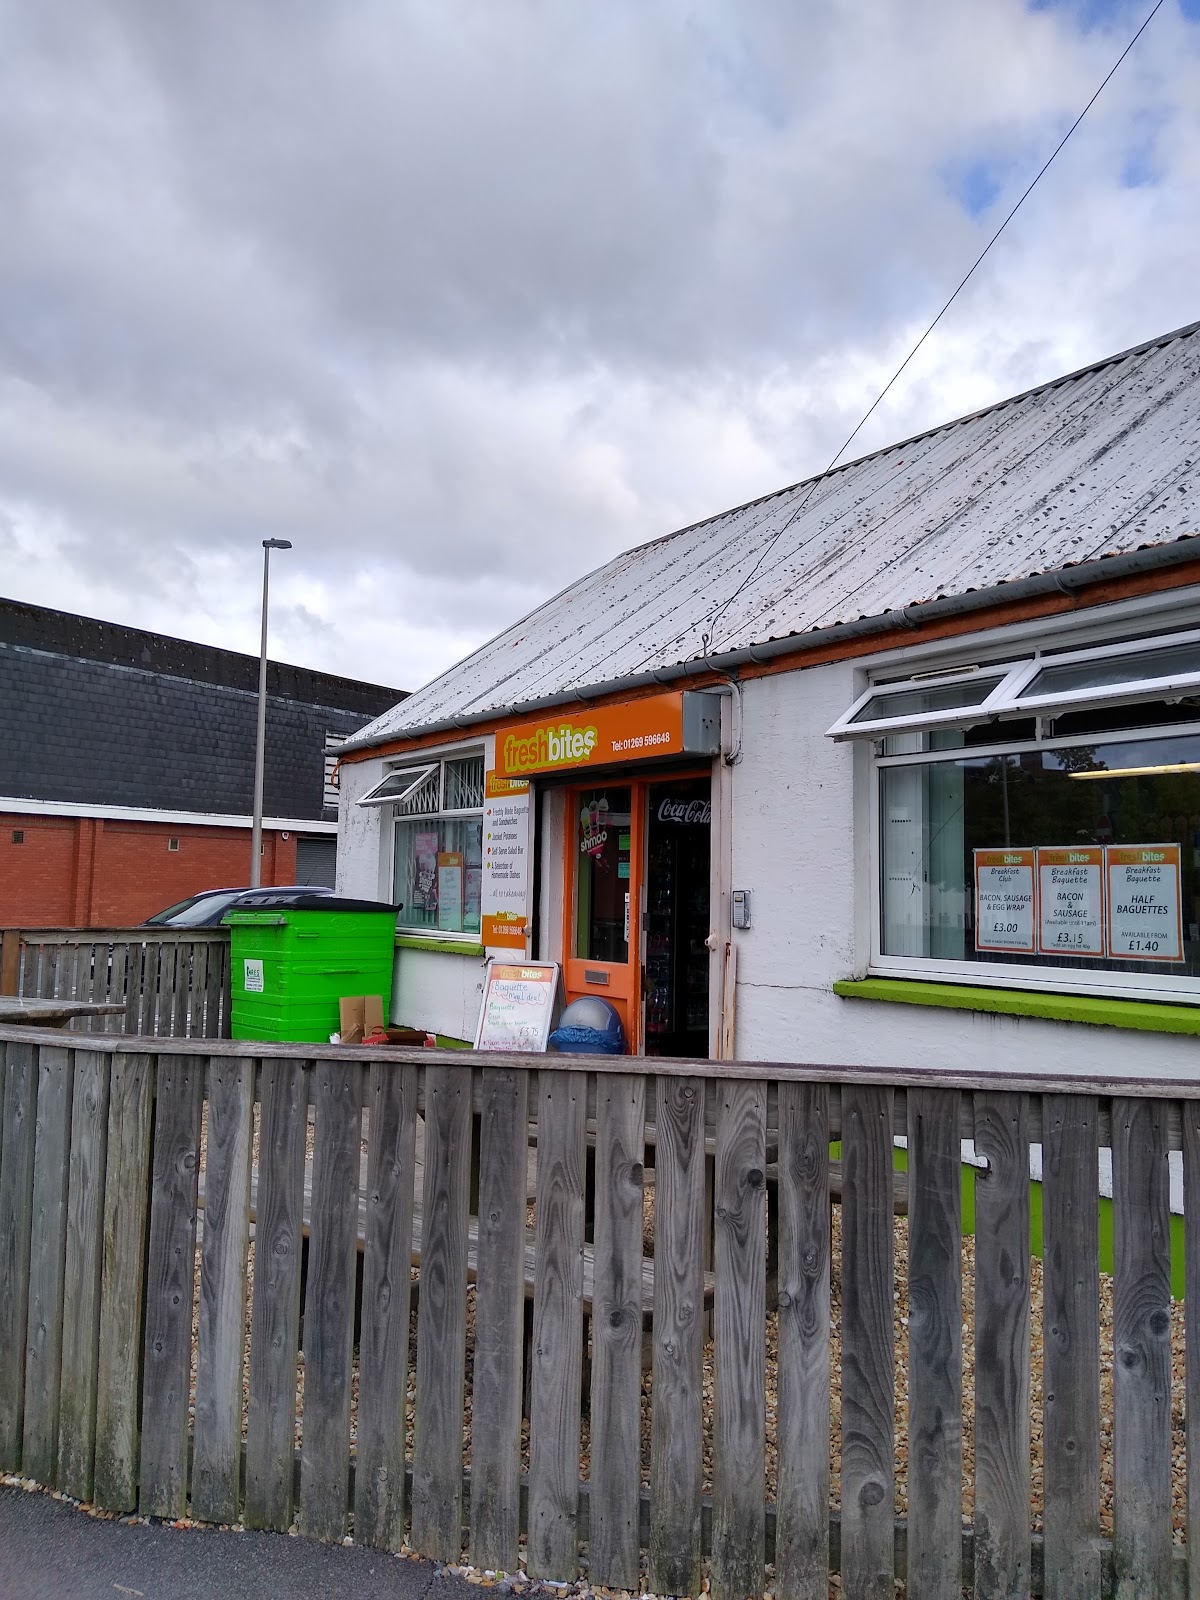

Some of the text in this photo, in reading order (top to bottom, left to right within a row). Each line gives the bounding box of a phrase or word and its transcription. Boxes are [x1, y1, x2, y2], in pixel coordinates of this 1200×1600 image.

[611, 732, 670, 752] Tel: 01269 596648
[503, 832, 518, 840] Potatoes
[580, 831, 608, 852] shmoo
[1052, 876, 1087, 885] Baguette
[1126, 875, 1160, 884] Baguette
[1132, 895, 1155, 904] HALF
[1117, 905, 1168, 914] BAGUETTES
[993, 922, 1018, 932] £3.00
[1057, 933, 1083, 944] £3.15
[1128, 940, 1159, 951] £1.40
[494, 981, 528, 996] Baguette
[527, 993, 541, 1001] deal
[490, 1002, 515, 1012] Baguette
